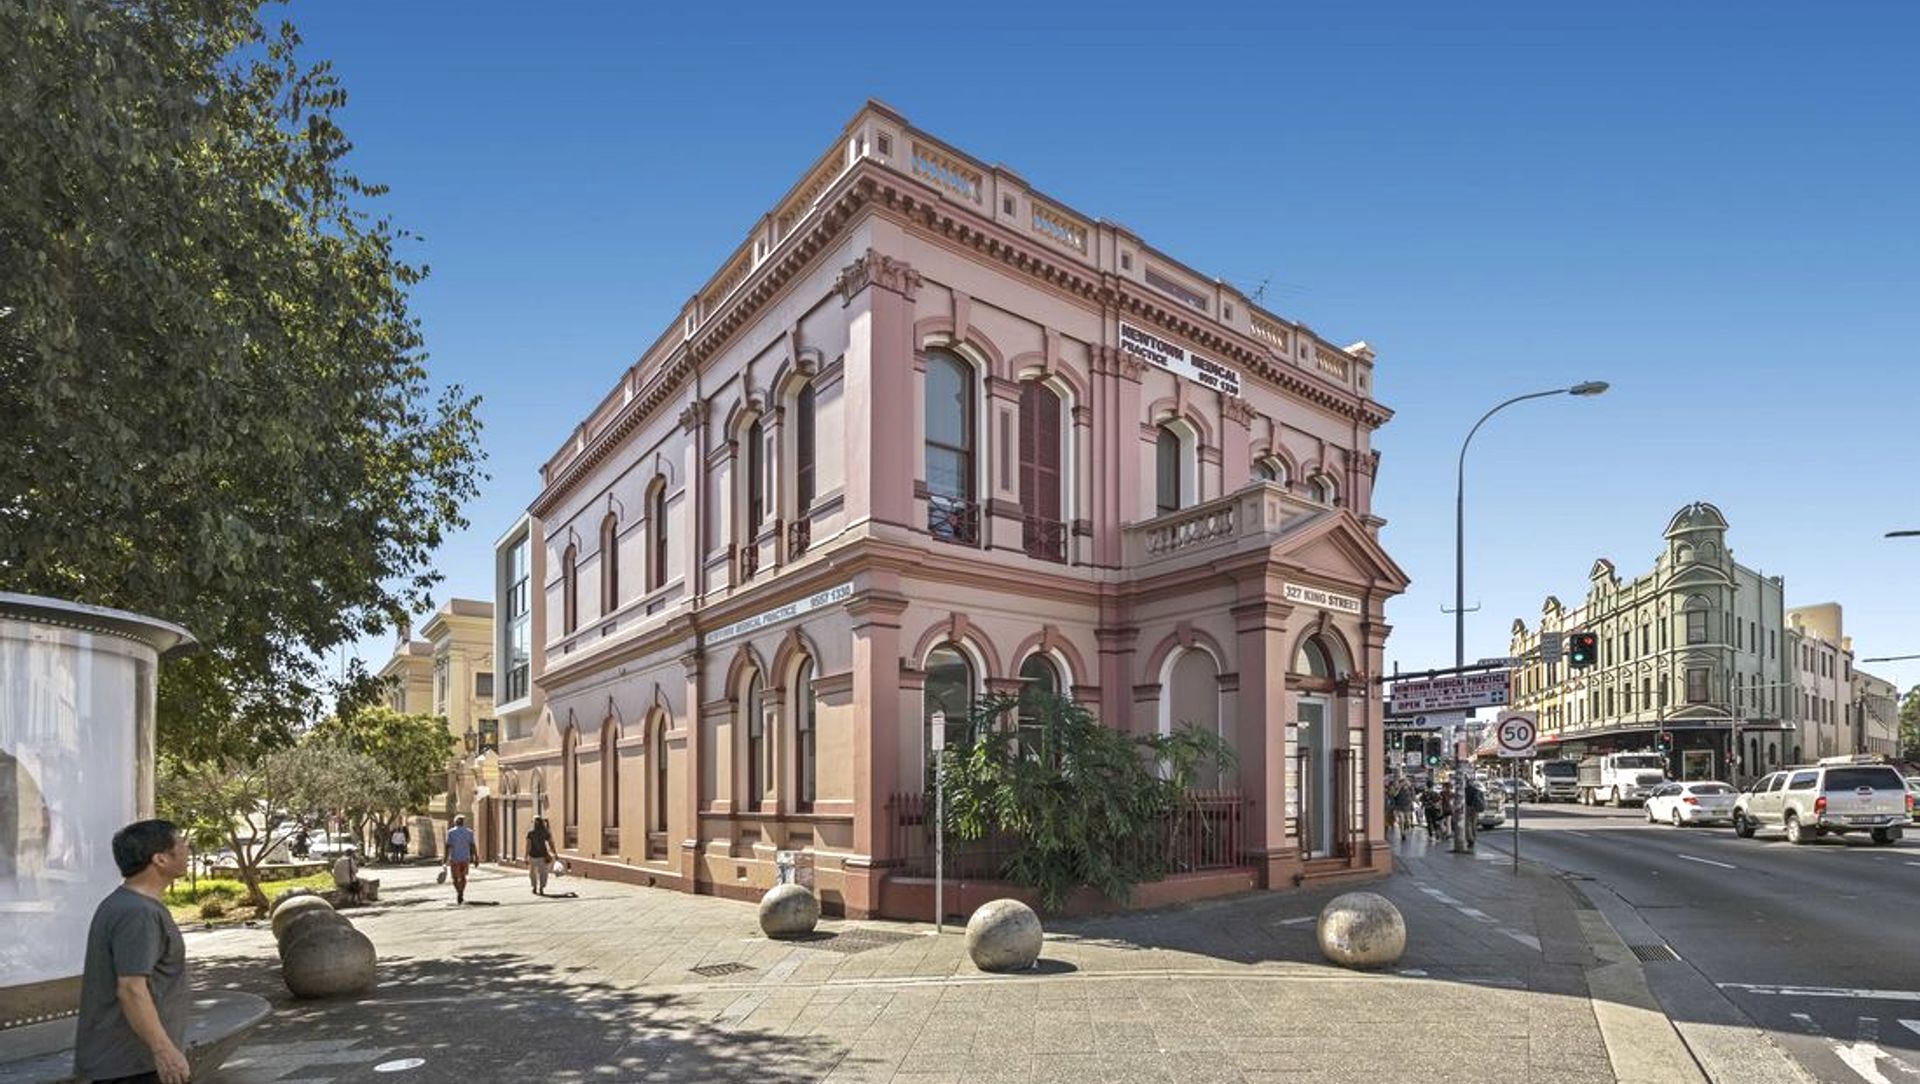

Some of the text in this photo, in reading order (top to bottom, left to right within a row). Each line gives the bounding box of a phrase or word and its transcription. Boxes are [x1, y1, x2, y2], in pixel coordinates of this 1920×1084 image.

[1121, 339, 1169, 366] PRACTICE
[1121, 323, 1239, 384] NEWTOWN MEDICAL
[1286, 585, 1360, 610] 327 KING STREET
[763, 605, 797, 623] PRACTICE
[1433, 678, 1465, 690] MEDICAL
[1467, 673, 1506, 686] PRACTICE
[1398, 700, 1420, 710] OPEN
[1504, 725, 1529, 742] 50
